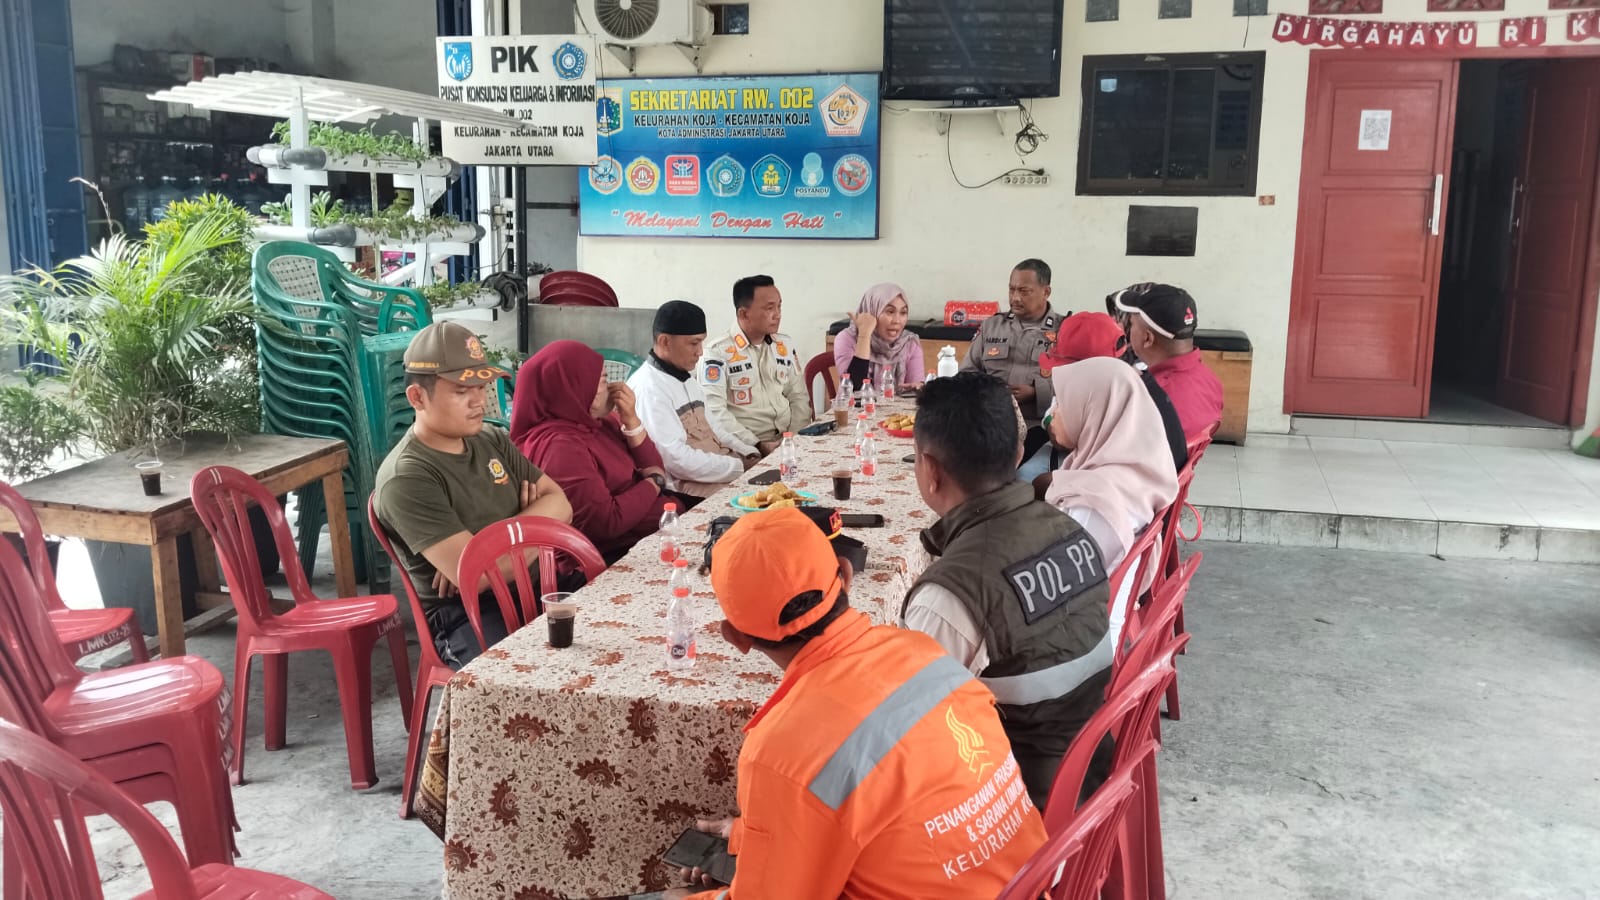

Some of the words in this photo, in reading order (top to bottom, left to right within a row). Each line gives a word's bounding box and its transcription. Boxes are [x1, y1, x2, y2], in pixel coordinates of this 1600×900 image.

[1277, 20, 1473, 45] DIRGAHAYU
[1504, 20, 1537, 40] RI
[490, 45, 539, 73] PIK
[440, 86, 464, 102] PUSAT
[466, 86, 508, 102] KONSULTASI
[510, 86, 548, 102] KELUARGA
[555, 85, 595, 102] INFORMASI
[630, 89, 737, 111] SEKRETARIAT
[743, 88, 774, 109] RW.
[780, 87, 814, 109] 002
[454, 126, 501, 137] KELURAHAN
[562, 126, 584, 137] KOJA
[634, 114, 689, 127] KELURAHAN
[691, 114, 717, 126] KOJA
[725, 113, 782, 126] KECAMATAN
[785, 112, 811, 126] KOJA
[658, 128, 676, 138] KOTA
[678, 128, 727, 138] ADMINISTRASI
[728, 128, 760, 138] JAKARTA
[761, 127, 786, 138] UTARA
[484, 145, 522, 157] JAKARTA
[527, 145, 554, 157] UTARA
[623, 210, 700, 229] Melayani
[710, 211, 772, 232] Dengan
[783, 212, 825, 229] Hati
[1013, 557, 1072, 613] POL
[1066, 539, 1096, 584] PP
[924, 778, 998, 839] PENANGANAN
[966, 825, 978, 843] &
[975, 795, 1010, 835] SARANA
[942, 807, 1023, 880] KELURAHAN
